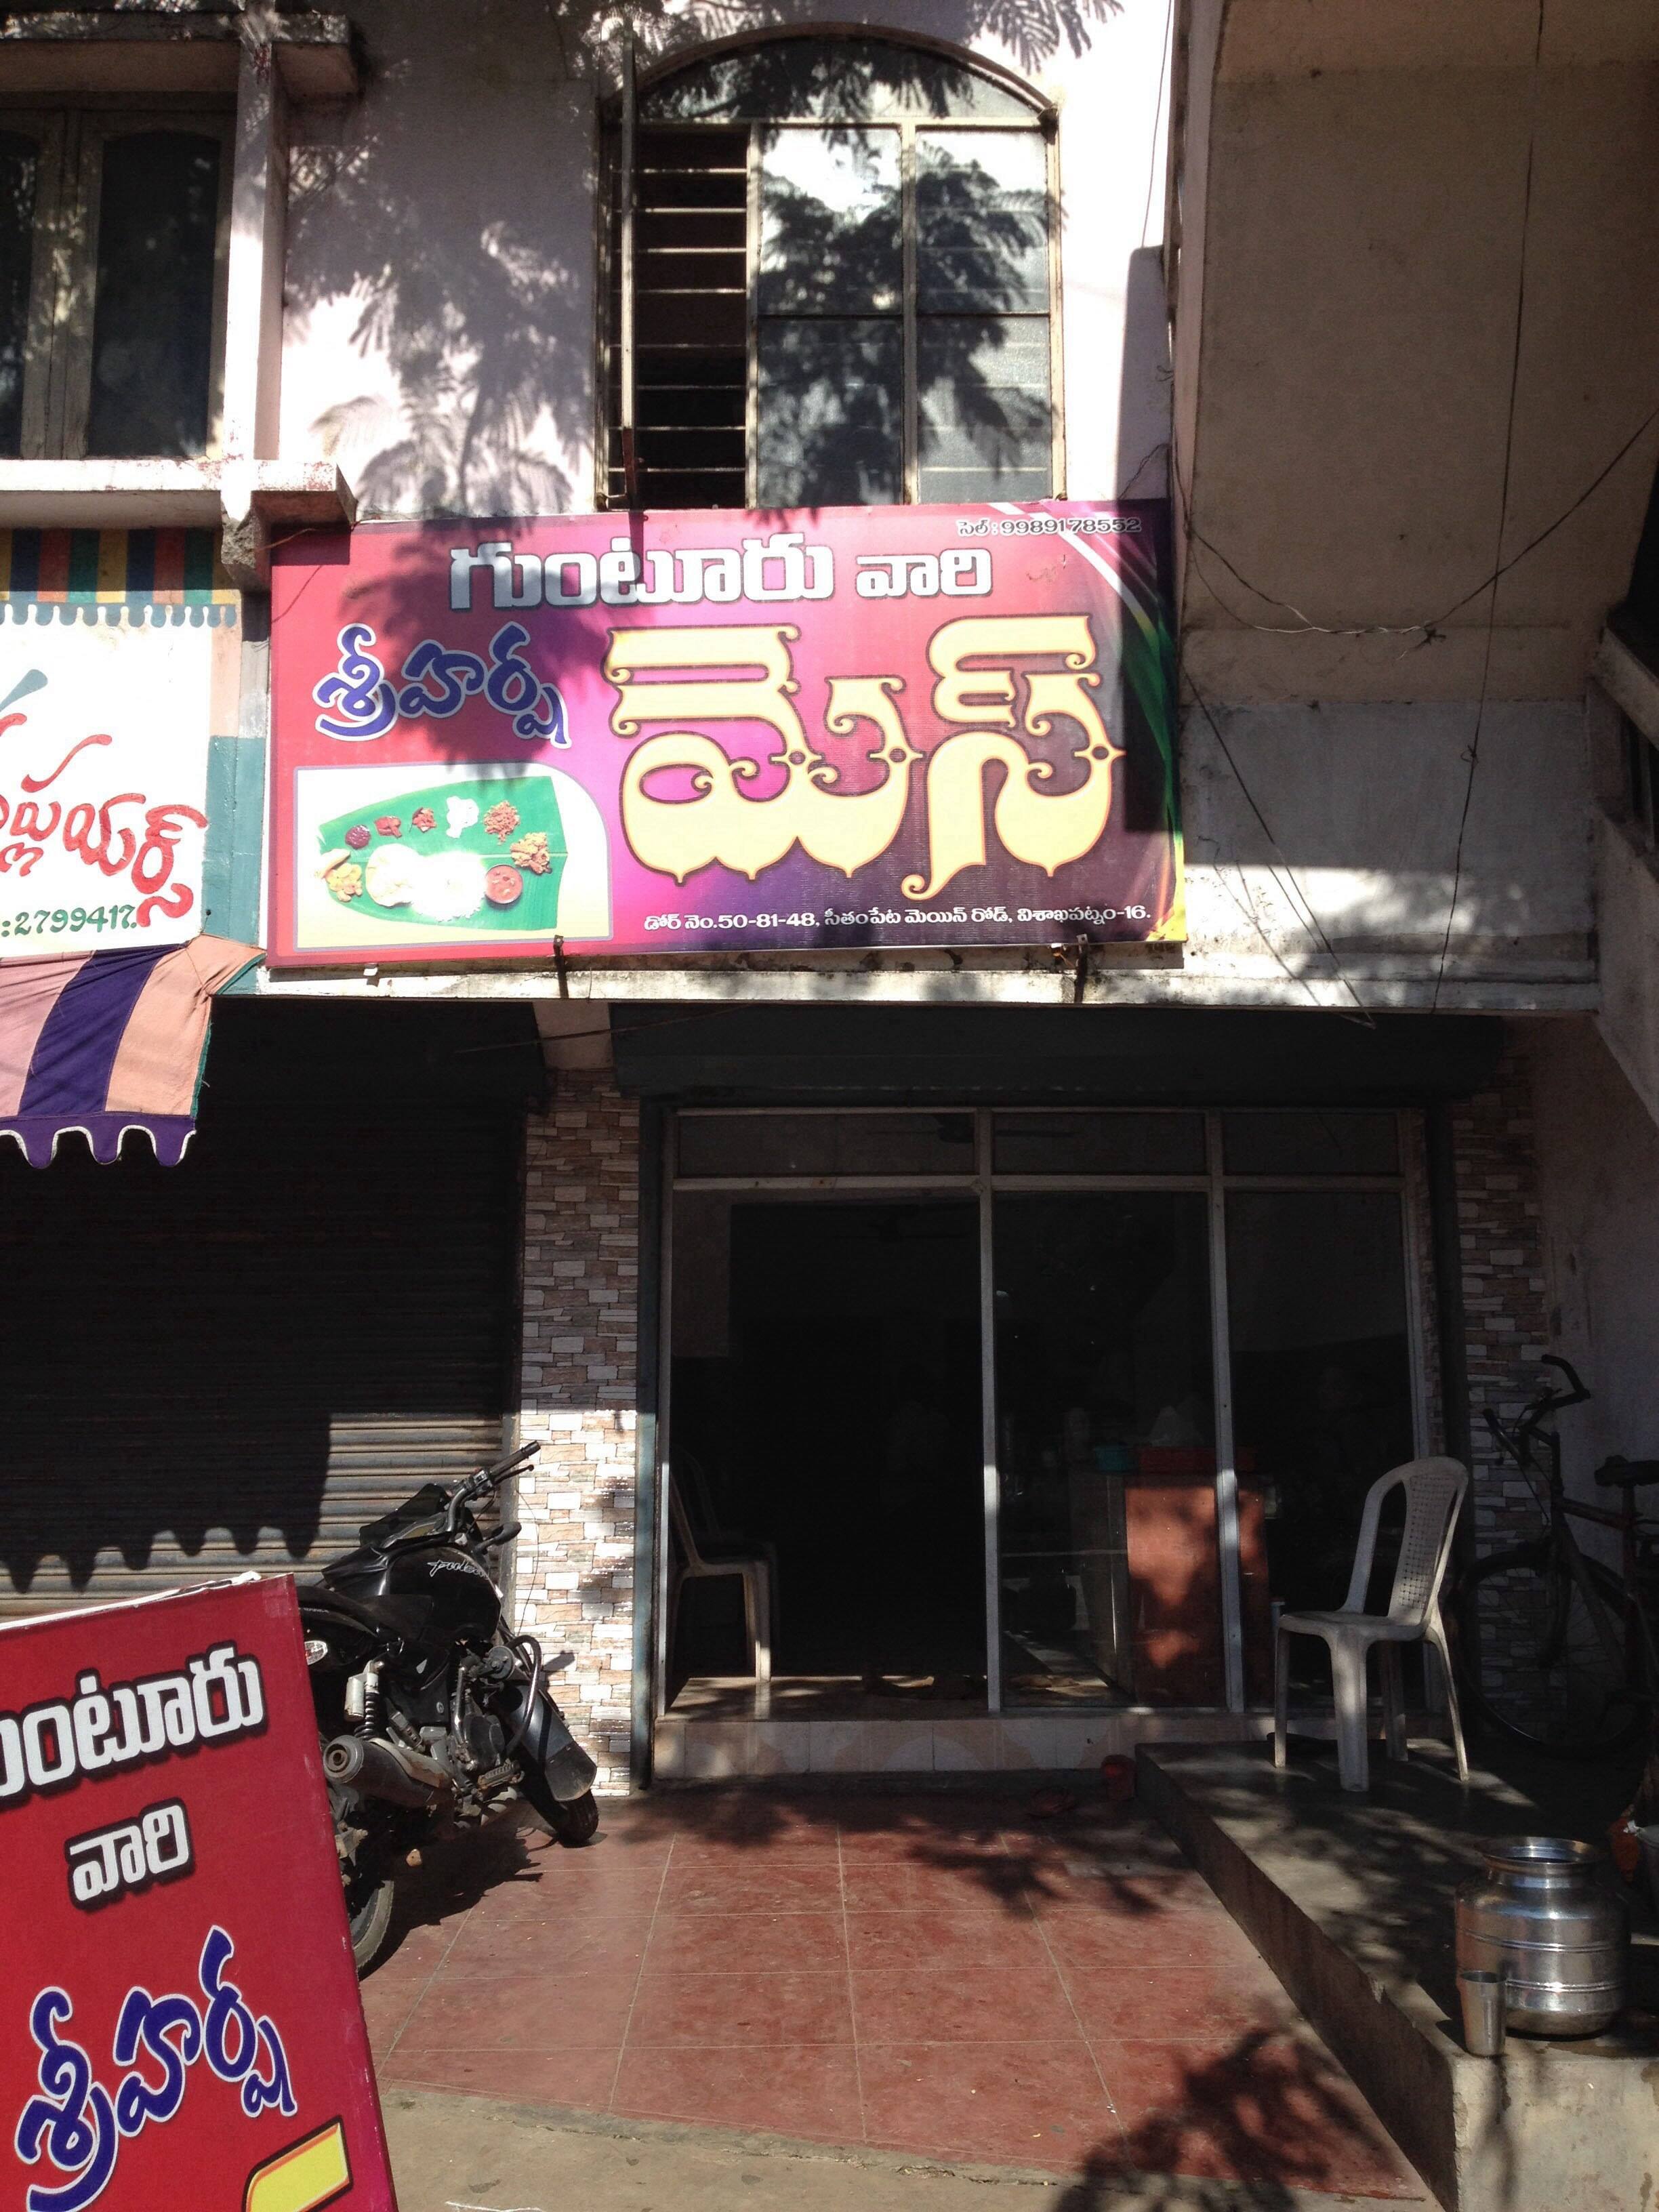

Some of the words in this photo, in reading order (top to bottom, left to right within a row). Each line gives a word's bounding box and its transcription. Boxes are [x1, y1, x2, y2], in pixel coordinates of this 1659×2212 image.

[450, 532, 834, 611] గుంటూరు
[856, 546, 994, 600] వారి
[312, 621, 572, 749] శ్రీహర్ష
[601, 613, 1126, 900] మెస్
[0, 718, 208, 927] ప్లయర్స్
[644, 914, 681, 930] డోర్
[824, 907, 901, 926] సీతంపేట
[904, 907, 968, 924] మెయిన్
[67, 1800, 193, 1906] వారి
